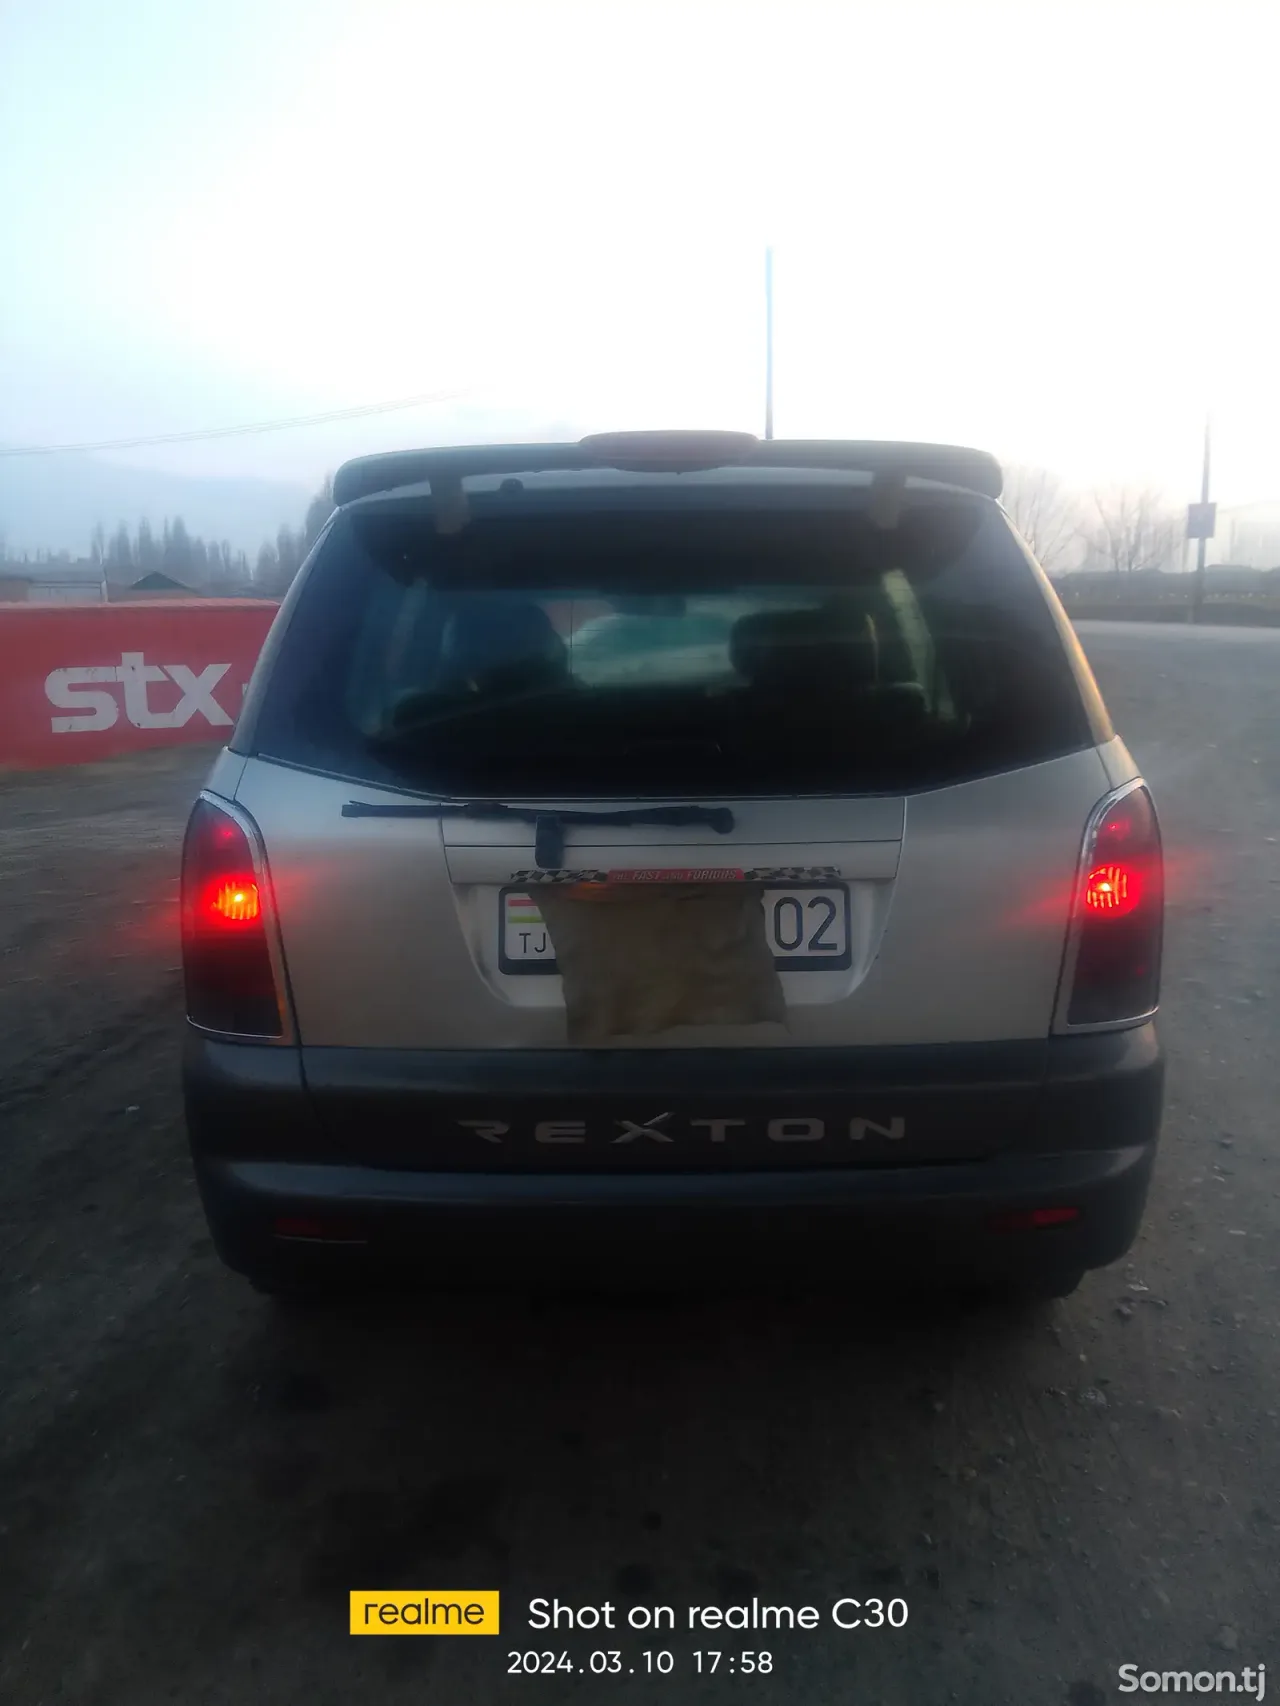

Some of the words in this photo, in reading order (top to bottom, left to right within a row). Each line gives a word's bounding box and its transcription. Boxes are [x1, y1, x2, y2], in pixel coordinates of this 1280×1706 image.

[633, 870, 661, 881] FAST
[688, 869, 737, 880] FURIOUS
[773, 896, 838, 951] 02
[519, 932, 546, 953] TJ
[457, 1112, 905, 1144] REXTON
